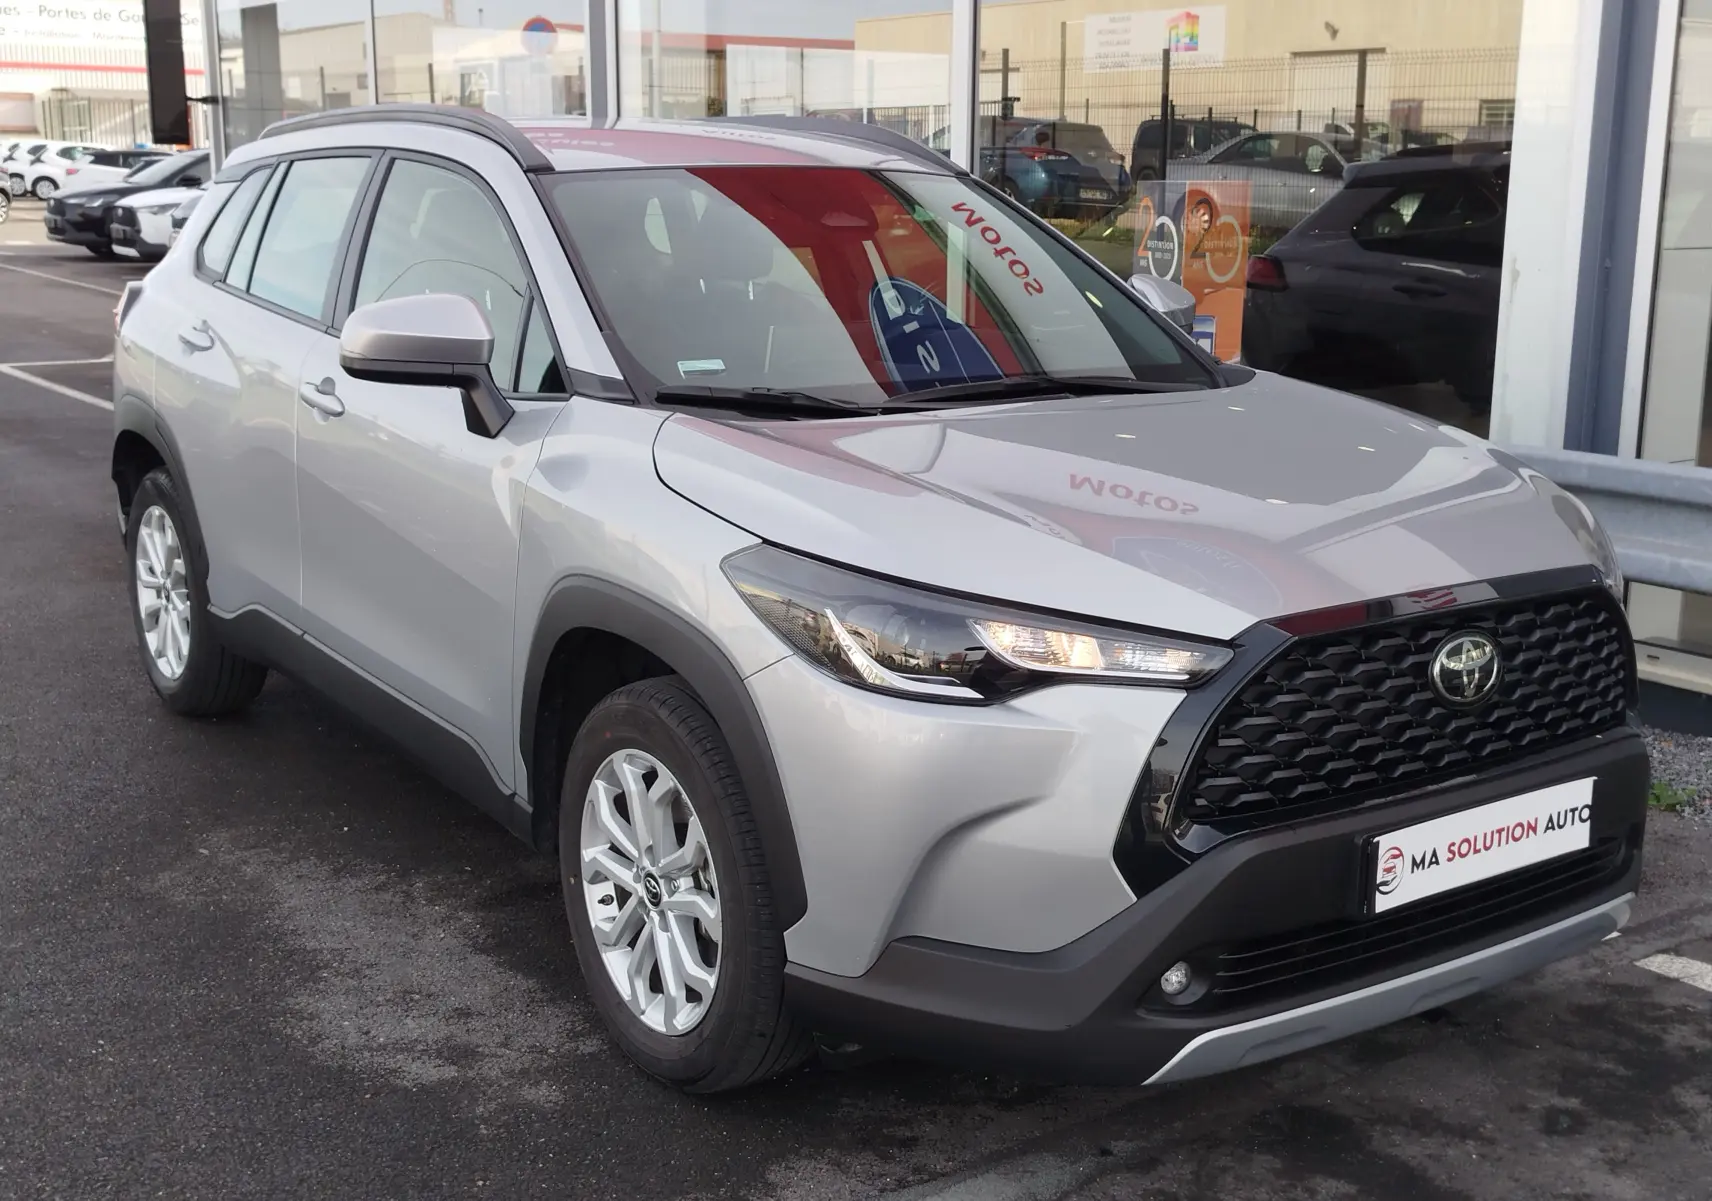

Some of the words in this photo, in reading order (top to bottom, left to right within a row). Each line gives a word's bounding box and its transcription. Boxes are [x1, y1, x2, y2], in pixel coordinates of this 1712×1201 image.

[38, 4, 86, 20] Portes
[93, 7, 112, 22] de
[118, 9, 145, 24] Ga
[1410, 847, 1440, 874] MA
[1446, 817, 1539, 863] SOLUTION
[1543, 803, 1592, 834] AUTO
